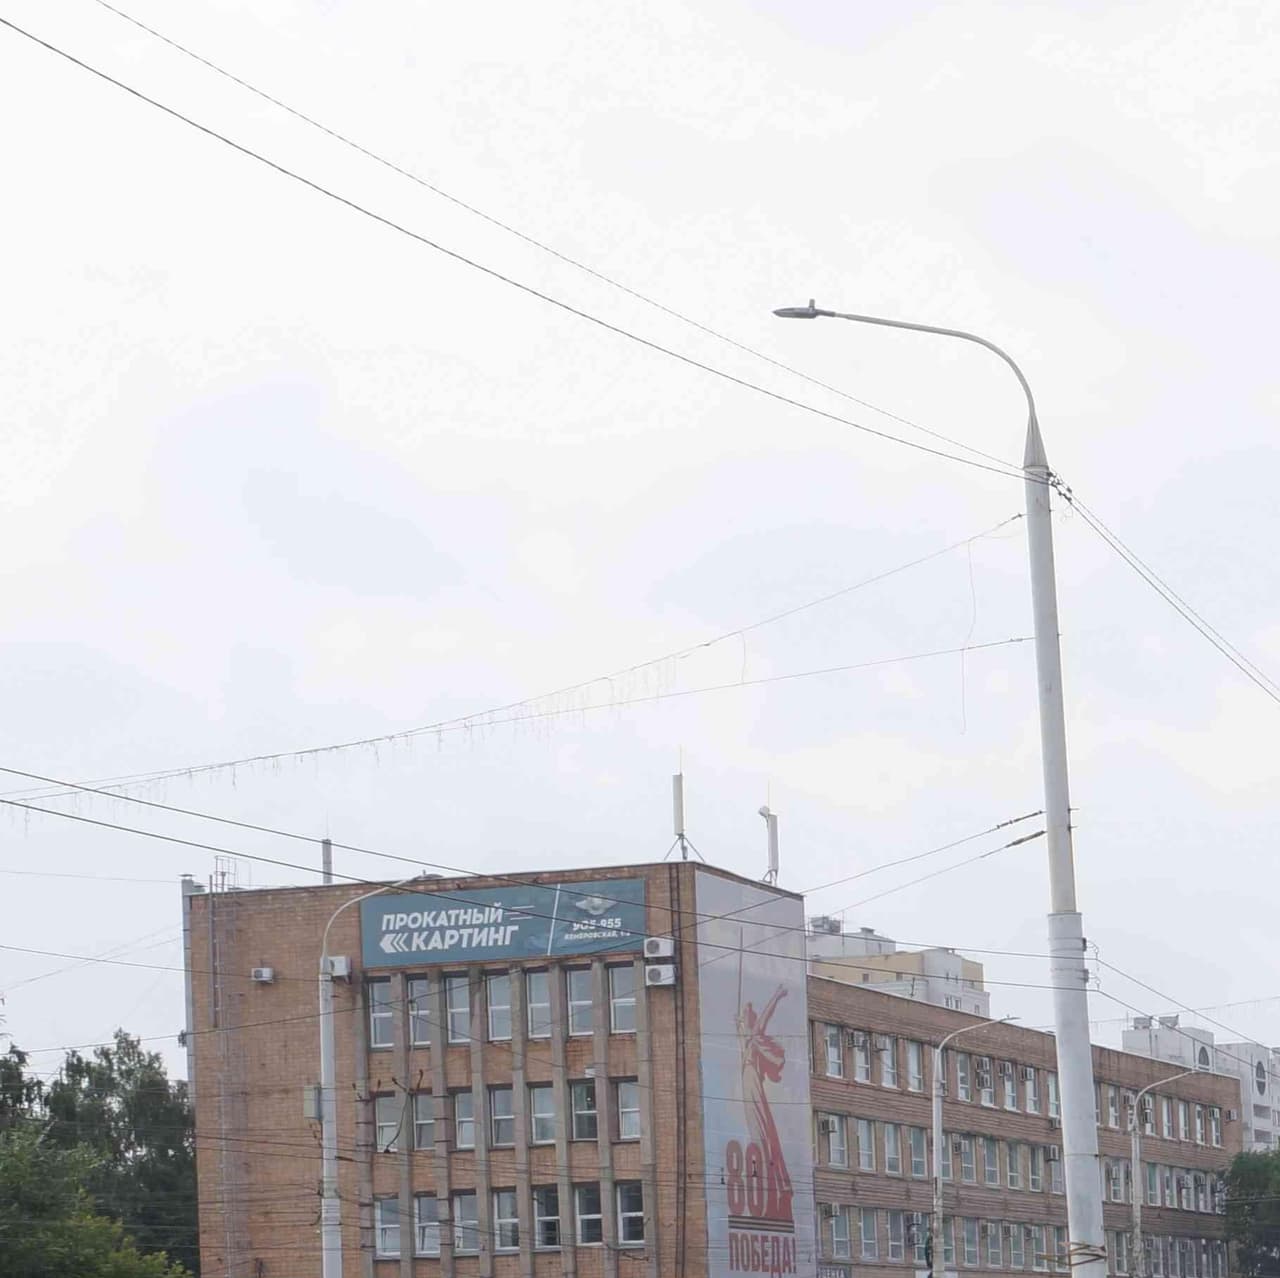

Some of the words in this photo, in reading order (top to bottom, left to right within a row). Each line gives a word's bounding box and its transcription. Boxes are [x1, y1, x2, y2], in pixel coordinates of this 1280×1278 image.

[381, 902, 504, 931] ПРОКАТНЫЙ
[411, 925, 519, 952] КАРТИНГ
[726, 1140, 764, 1217] 80
